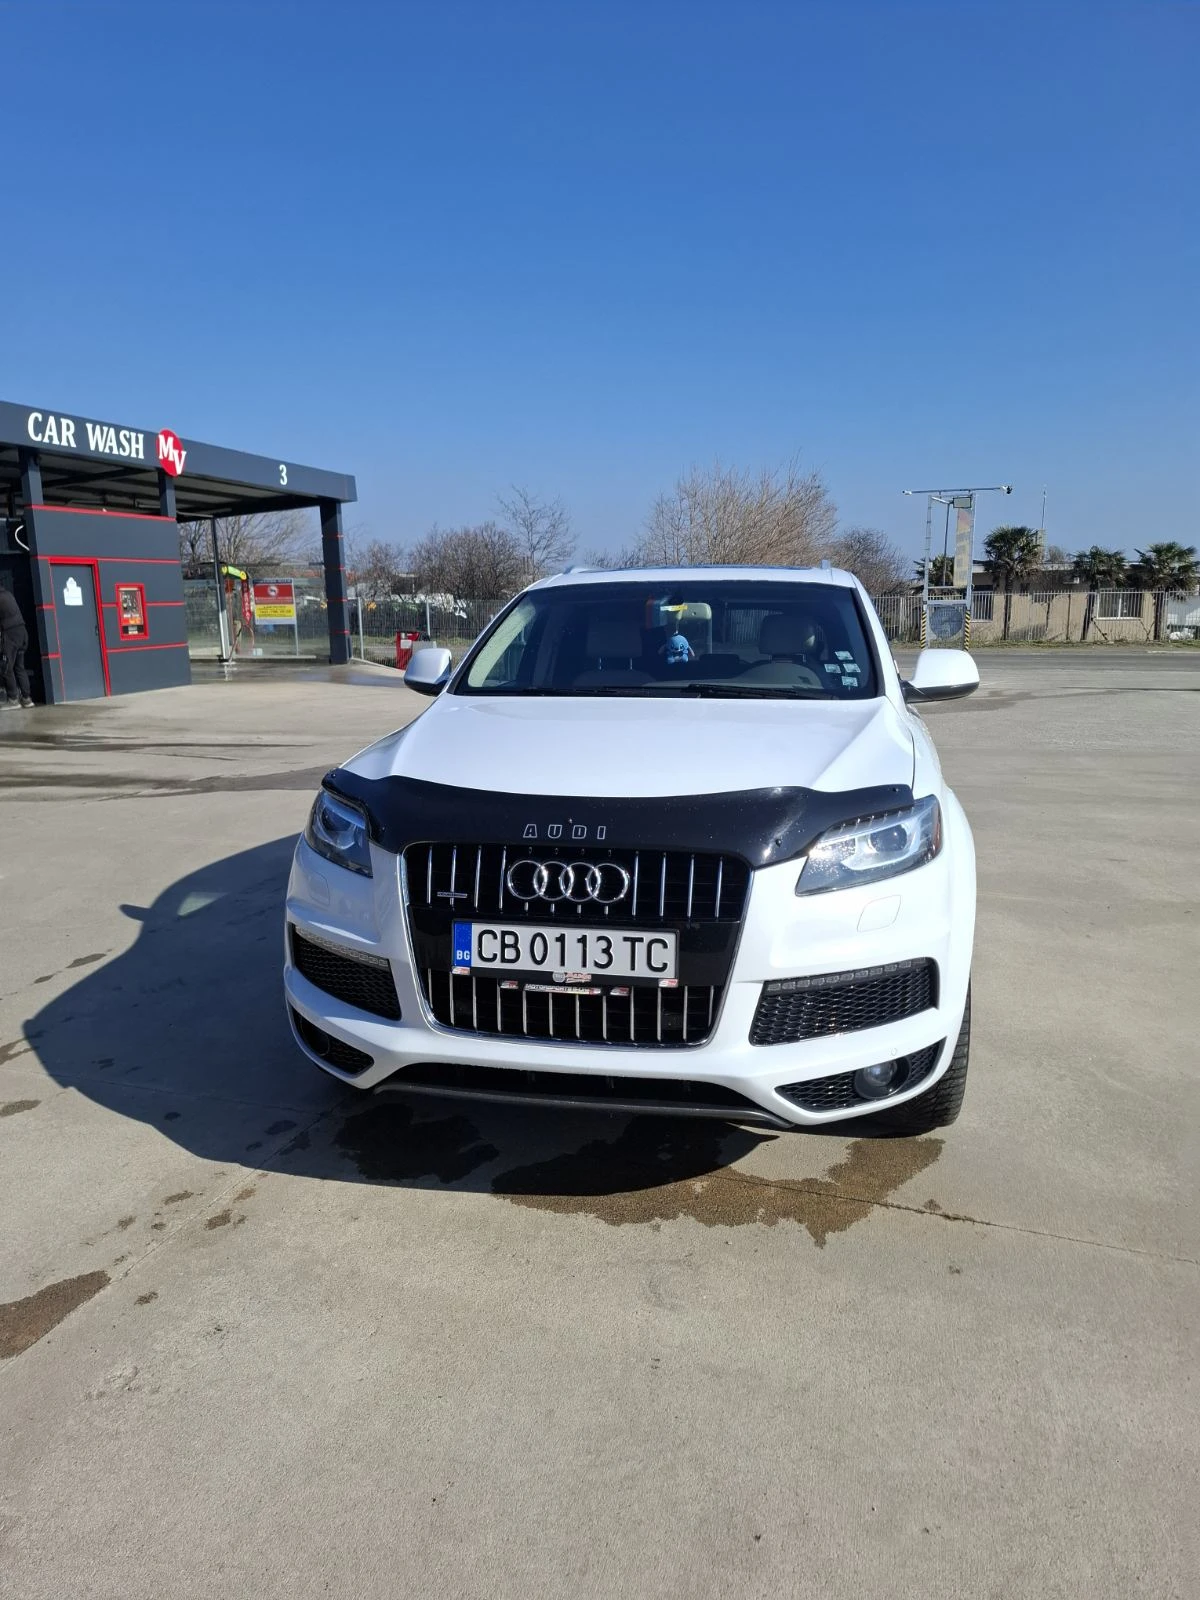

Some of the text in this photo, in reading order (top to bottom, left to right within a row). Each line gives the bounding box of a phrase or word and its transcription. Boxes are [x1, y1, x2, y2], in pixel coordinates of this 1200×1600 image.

[27, 411, 145, 460] CAR WASH
[157, 433, 188, 475] MV
[279, 464, 288, 486] 3
[522, 823, 607, 840] AUDI
[456, 950, 471, 961] BG
[529, 932, 614, 969] 0113
